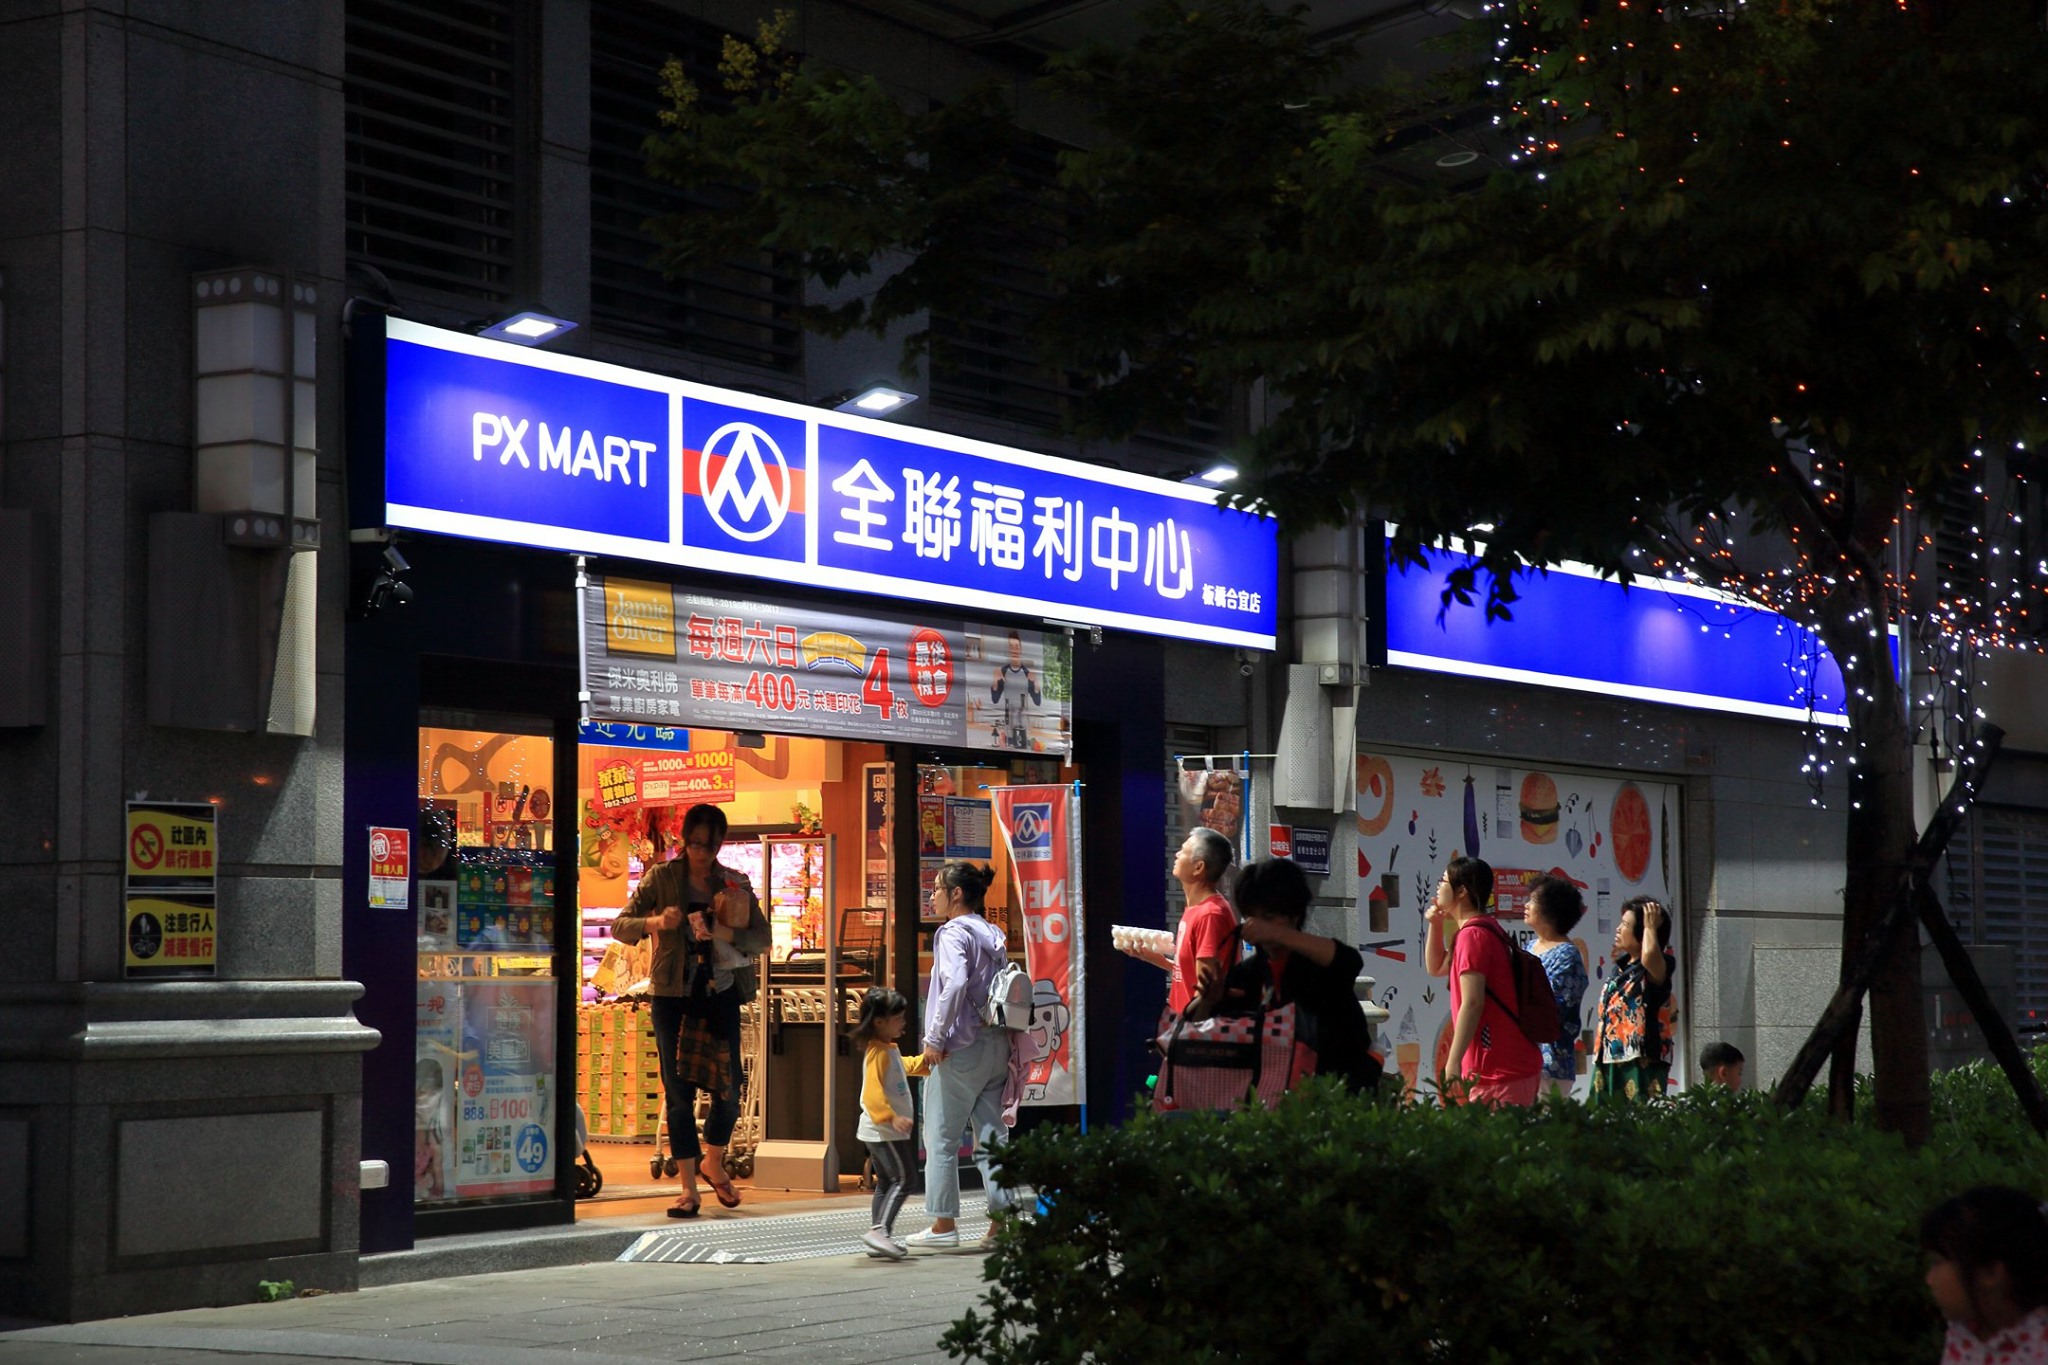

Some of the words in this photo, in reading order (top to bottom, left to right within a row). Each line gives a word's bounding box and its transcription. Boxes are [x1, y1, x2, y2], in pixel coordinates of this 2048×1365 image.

[472, 411, 530, 469] PX
[538, 423, 656, 488] MART
[831, 458, 1194, 600] 全聯福利中心
[613, 591, 669, 621] Jamie
[613, 615, 668, 643] Oliver
[686, 612, 798, 669] 每週六日
[915, 640, 946, 667] 最後
[917, 668, 948, 697] 機會
[171, 825, 207, 846] 社區內
[164, 912, 213, 933] 注意行人
